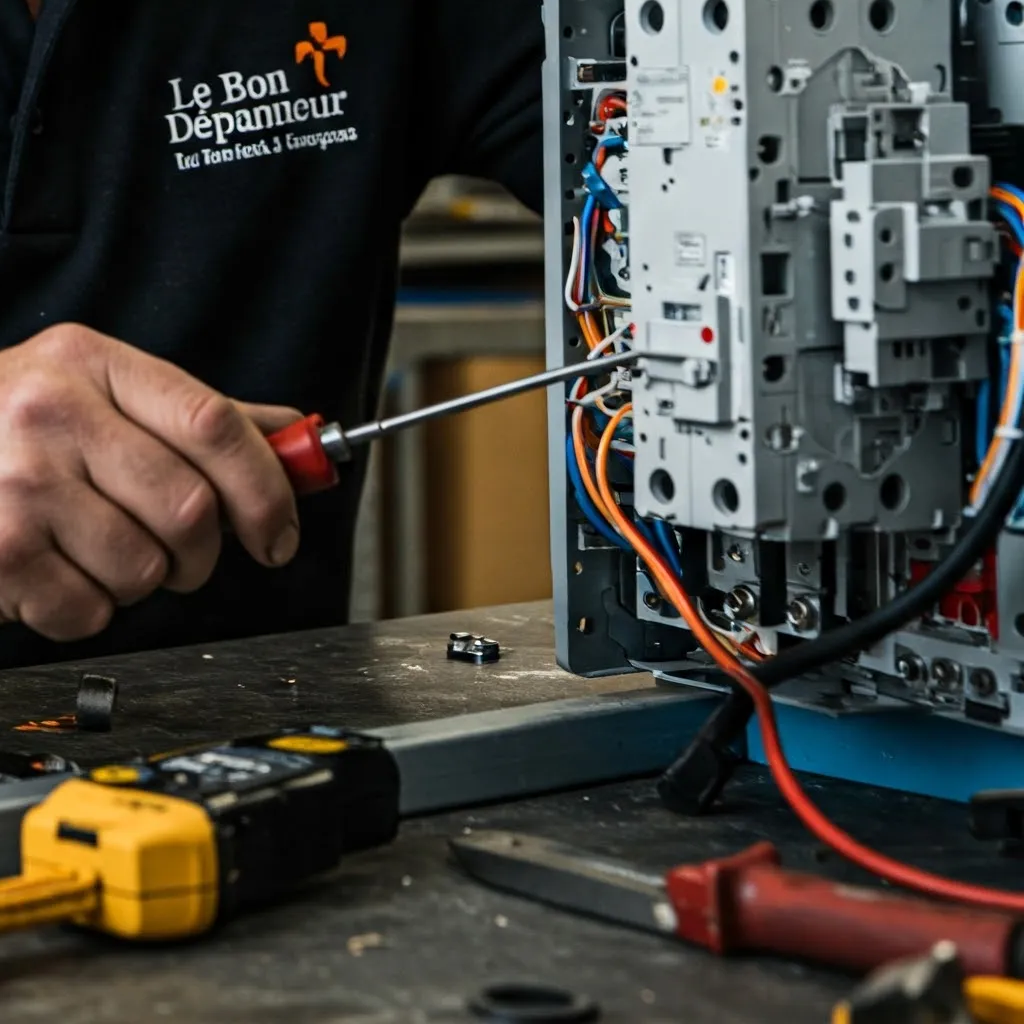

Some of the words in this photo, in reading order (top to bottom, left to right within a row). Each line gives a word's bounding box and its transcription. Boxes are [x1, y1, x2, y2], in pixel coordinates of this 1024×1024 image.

[168, 77, 212, 110] Le
[218, 69, 290, 106] Bon
[164, 90, 348, 144] Dépanneur
